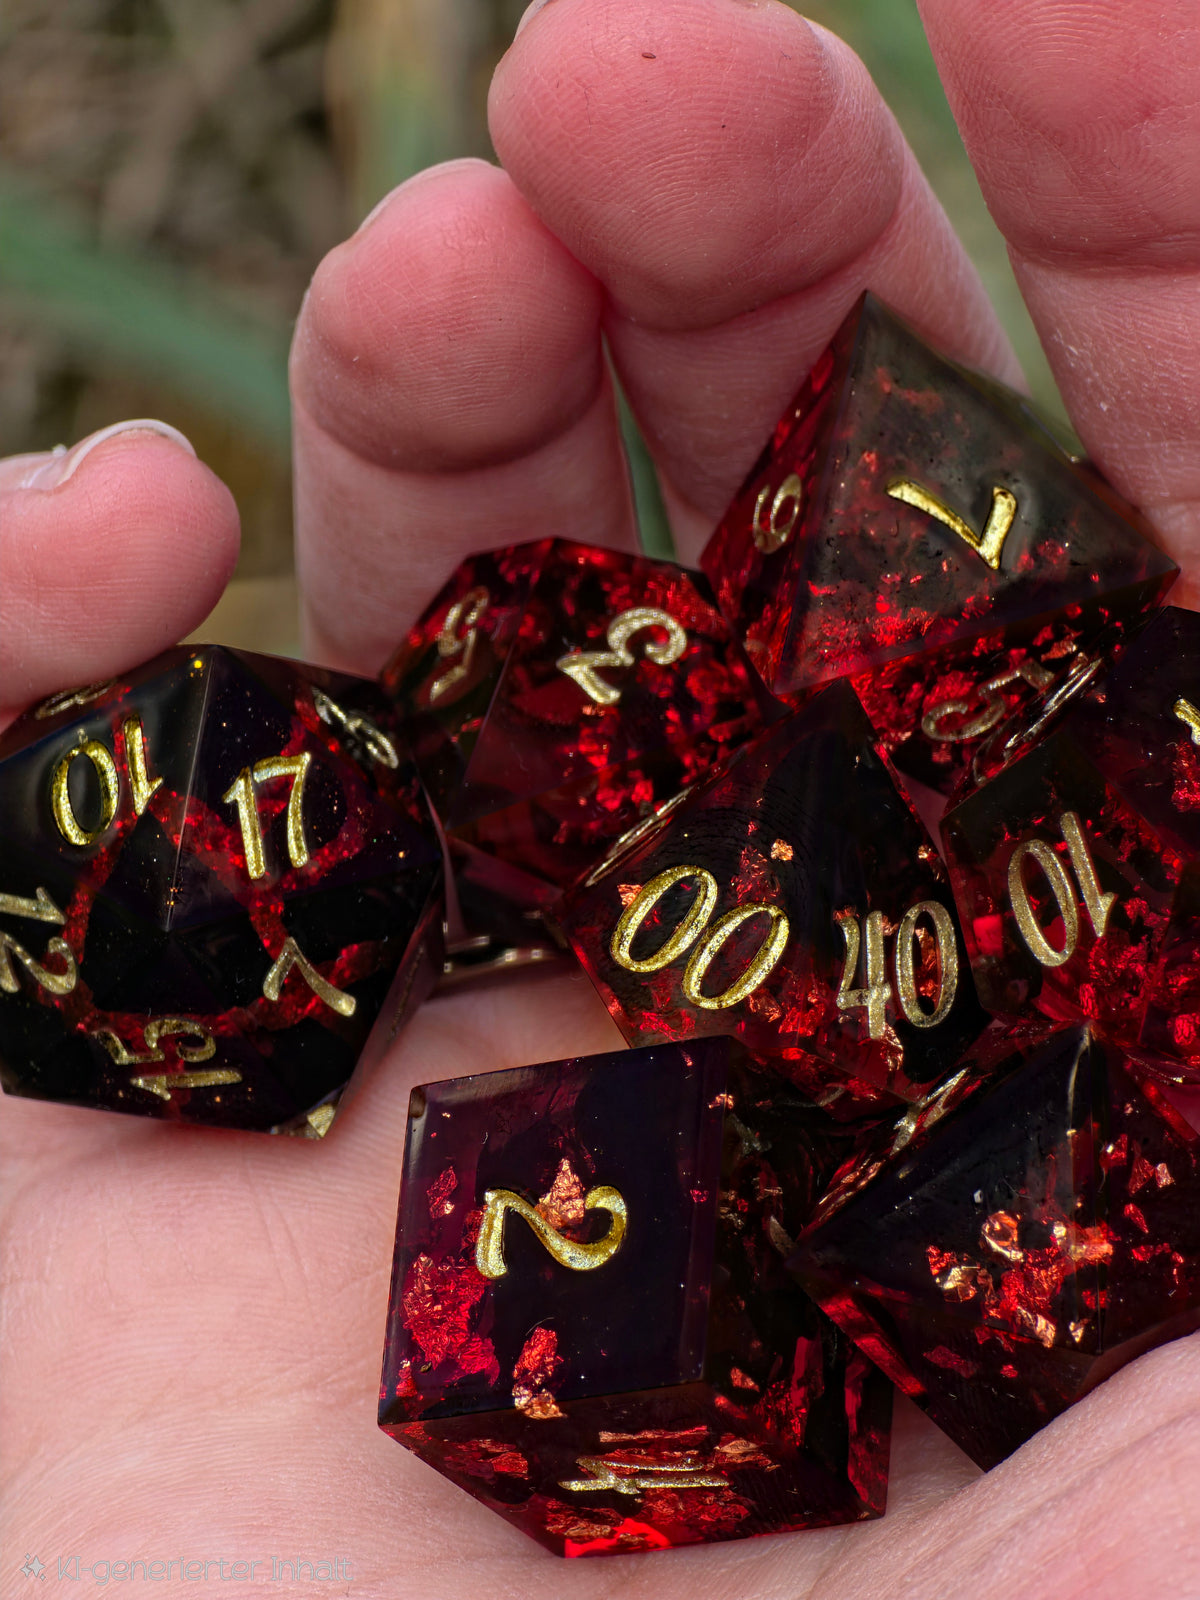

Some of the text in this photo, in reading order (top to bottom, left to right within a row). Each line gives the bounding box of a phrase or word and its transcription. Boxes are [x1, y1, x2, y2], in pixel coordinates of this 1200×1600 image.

[752, 474, 801, 555] 6
[885, 480, 1017, 570] 7
[51, 713, 163, 846] 10
[222, 752, 312, 880] 17
[609, 864, 790, 1010] 00
[1007, 810, 1116, 968] 10
[262, 936, 357, 1017] 7
[835, 900, 959, 1040] 40
[93, 1018, 243, 1101] 15
[475, 1184, 627, 1279] 2
